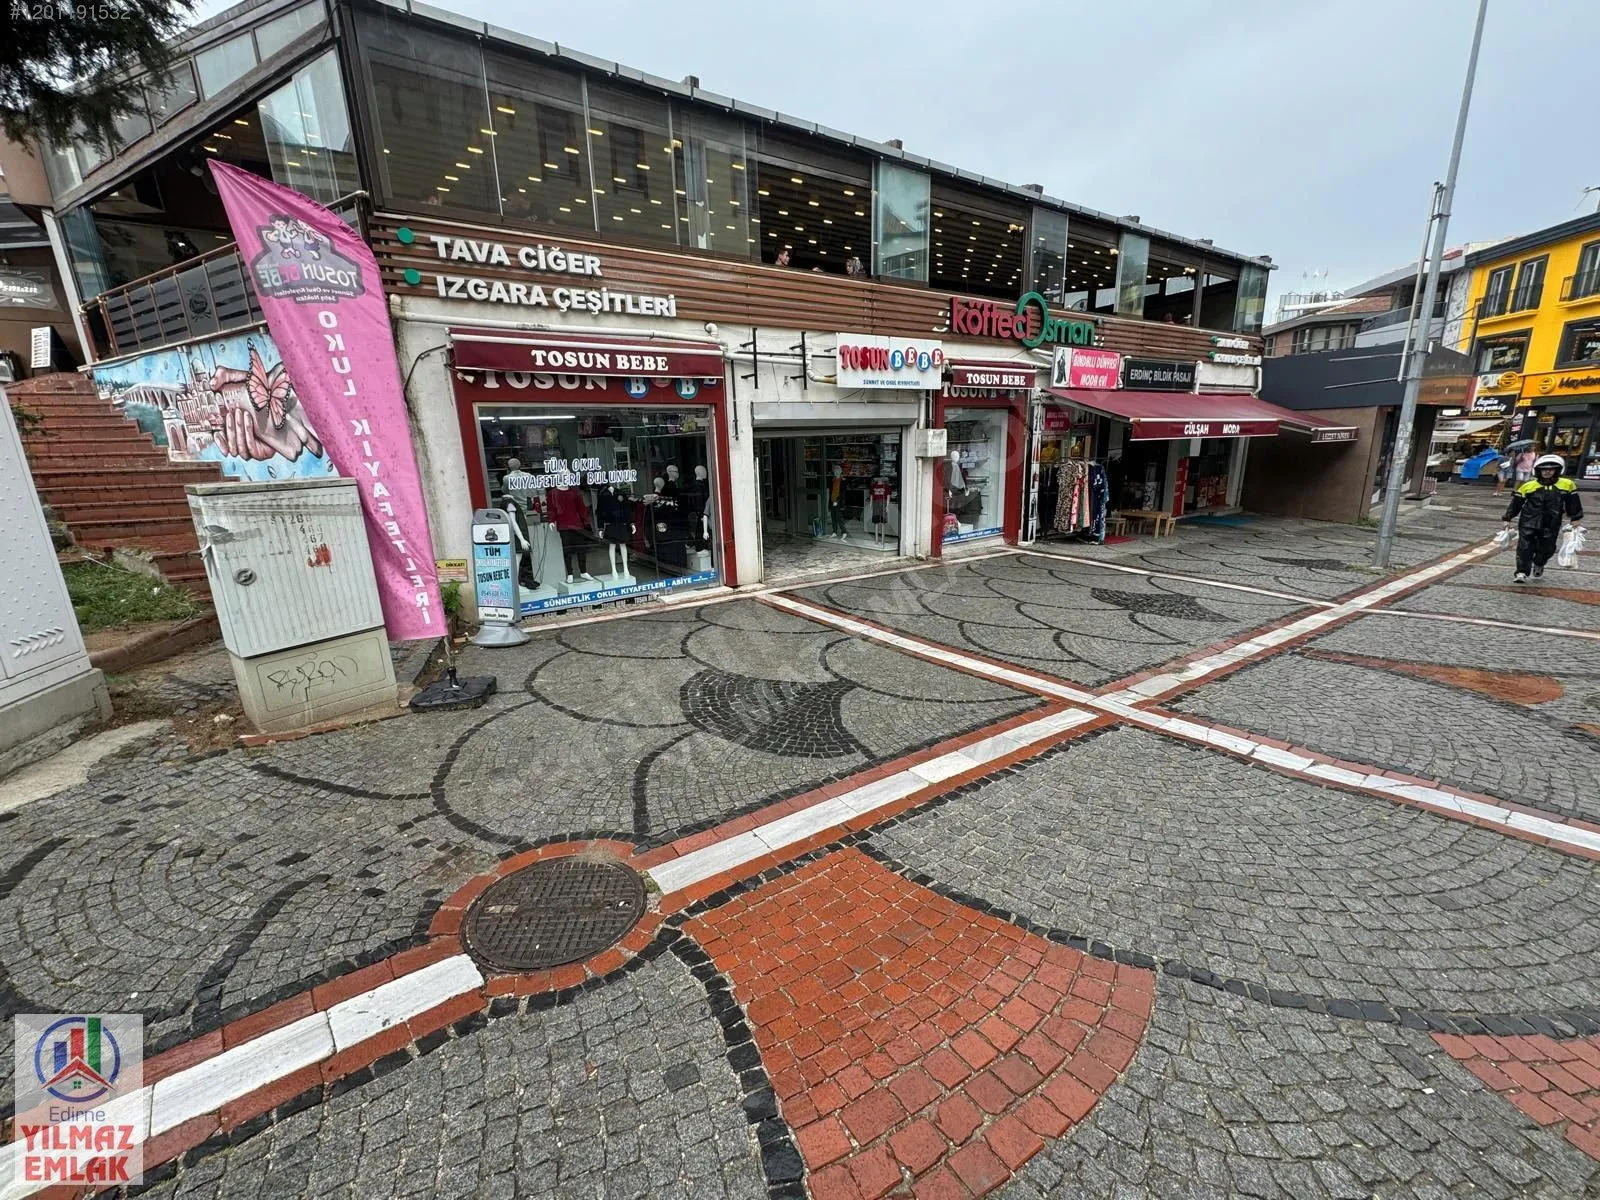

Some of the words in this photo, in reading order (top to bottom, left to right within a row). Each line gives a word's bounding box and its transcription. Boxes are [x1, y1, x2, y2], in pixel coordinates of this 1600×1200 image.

[430, 235, 510, 267] TAVA
[517, 244, 603, 277] CİĞER
[435, 275, 548, 307] IZGARA
[552, 286, 678, 318] ÇEŞİTLERİ
[531, 349, 611, 369] TOSUN
[616, 354, 669, 372] BEBE
[838, 344, 890, 371] TOSUN
[891, 346, 943, 372] BEBE
[966, 373, 1000, 385] TOSUN
[1001, 375, 1026, 386] BEBE
[1130, 368, 1152, 384] ERDİNÇ
[1153, 367, 1173, 382] BİLDİK
[1184, 421, 1209, 436] GÜLŞAH
[1222, 424, 1240, 434] MODA
[543, 456, 568, 474] TÜM
[571, 457, 602, 472] OKUL
[484, 547, 501, 557] TÜM
[543, 592, 591, 608] SÜNNETLİK
[596, 590, 618, 599] OKUL
[621, 580, 667, 595] KIYAFETLERİ
[672, 576, 692, 587] ABİYE
